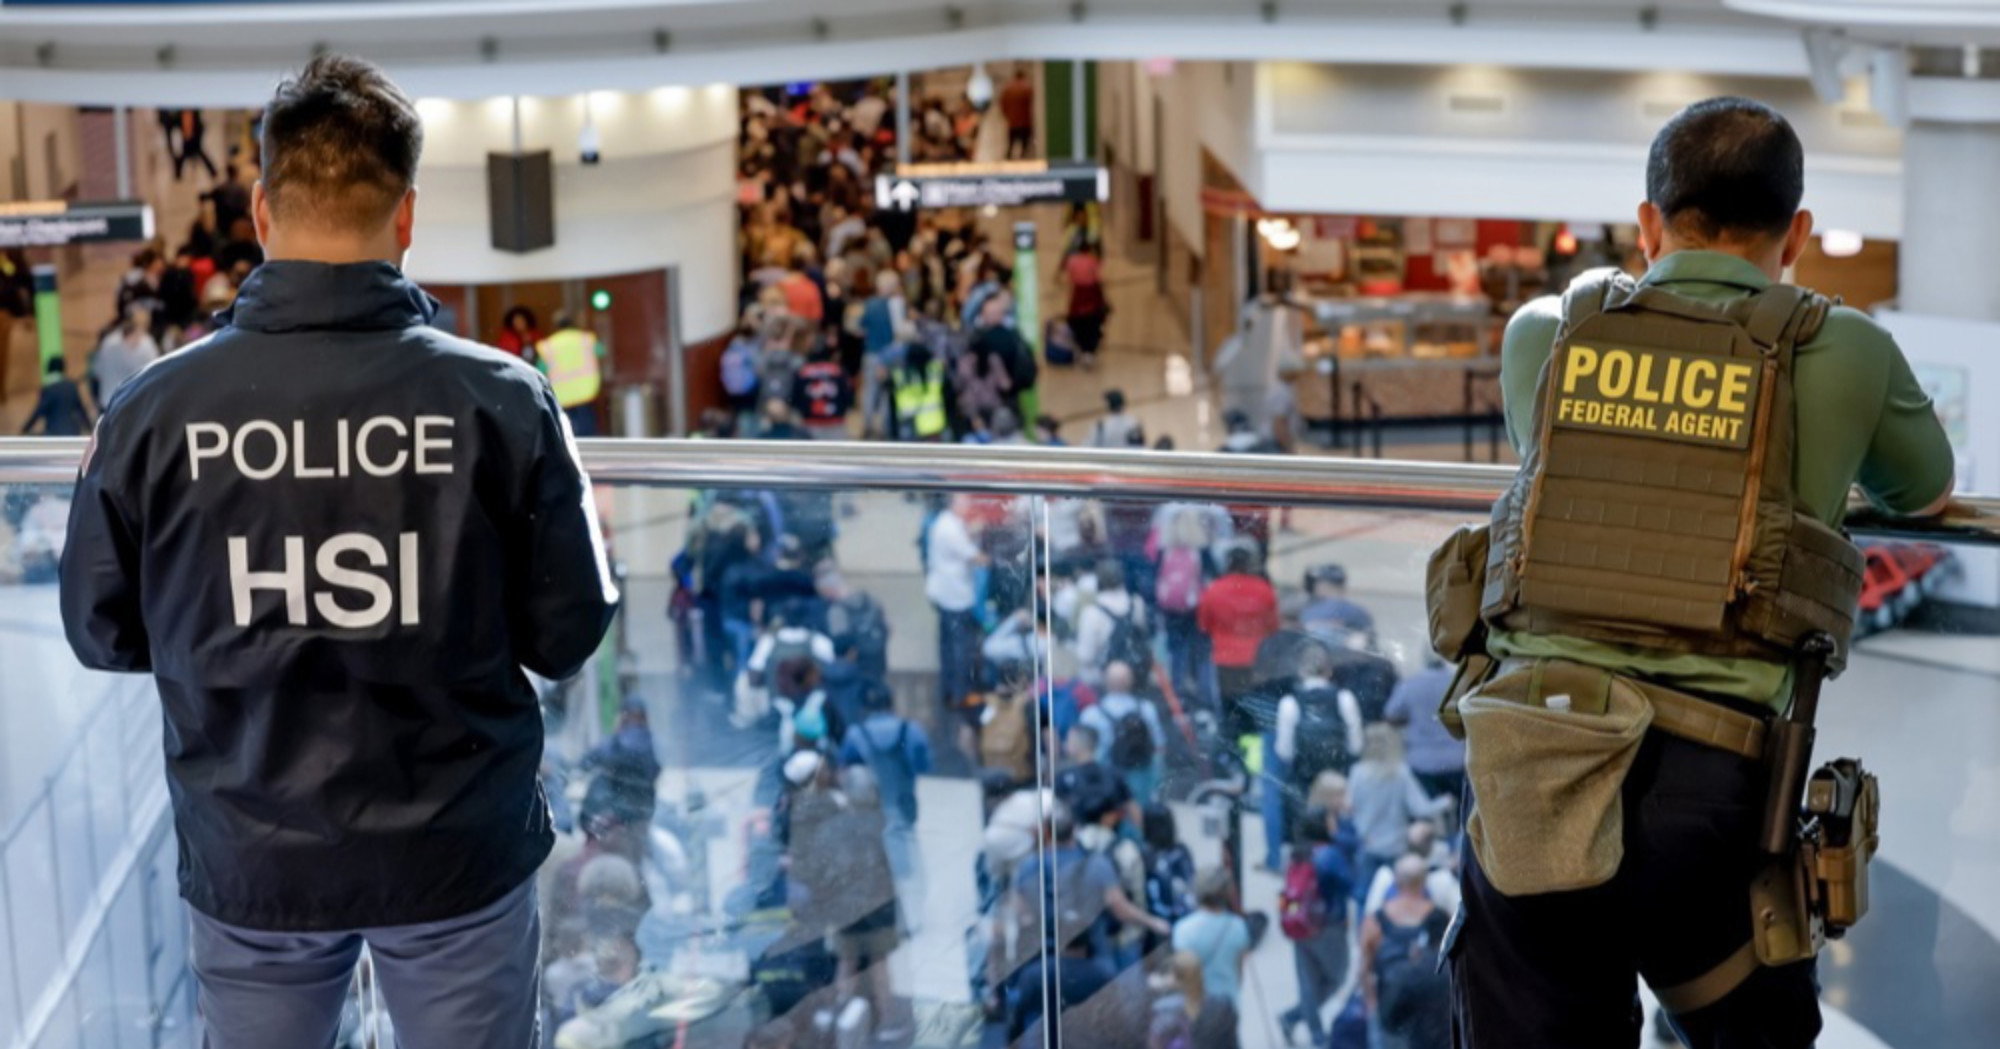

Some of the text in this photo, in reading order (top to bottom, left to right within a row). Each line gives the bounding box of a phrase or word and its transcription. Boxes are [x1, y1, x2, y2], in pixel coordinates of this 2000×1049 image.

[1562, 345, 1752, 413] POLICE
[185, 415, 455, 481] POLICE
[1558, 398, 1743, 441] FEDERAL AGENT
[227, 532, 419, 628] HSI
